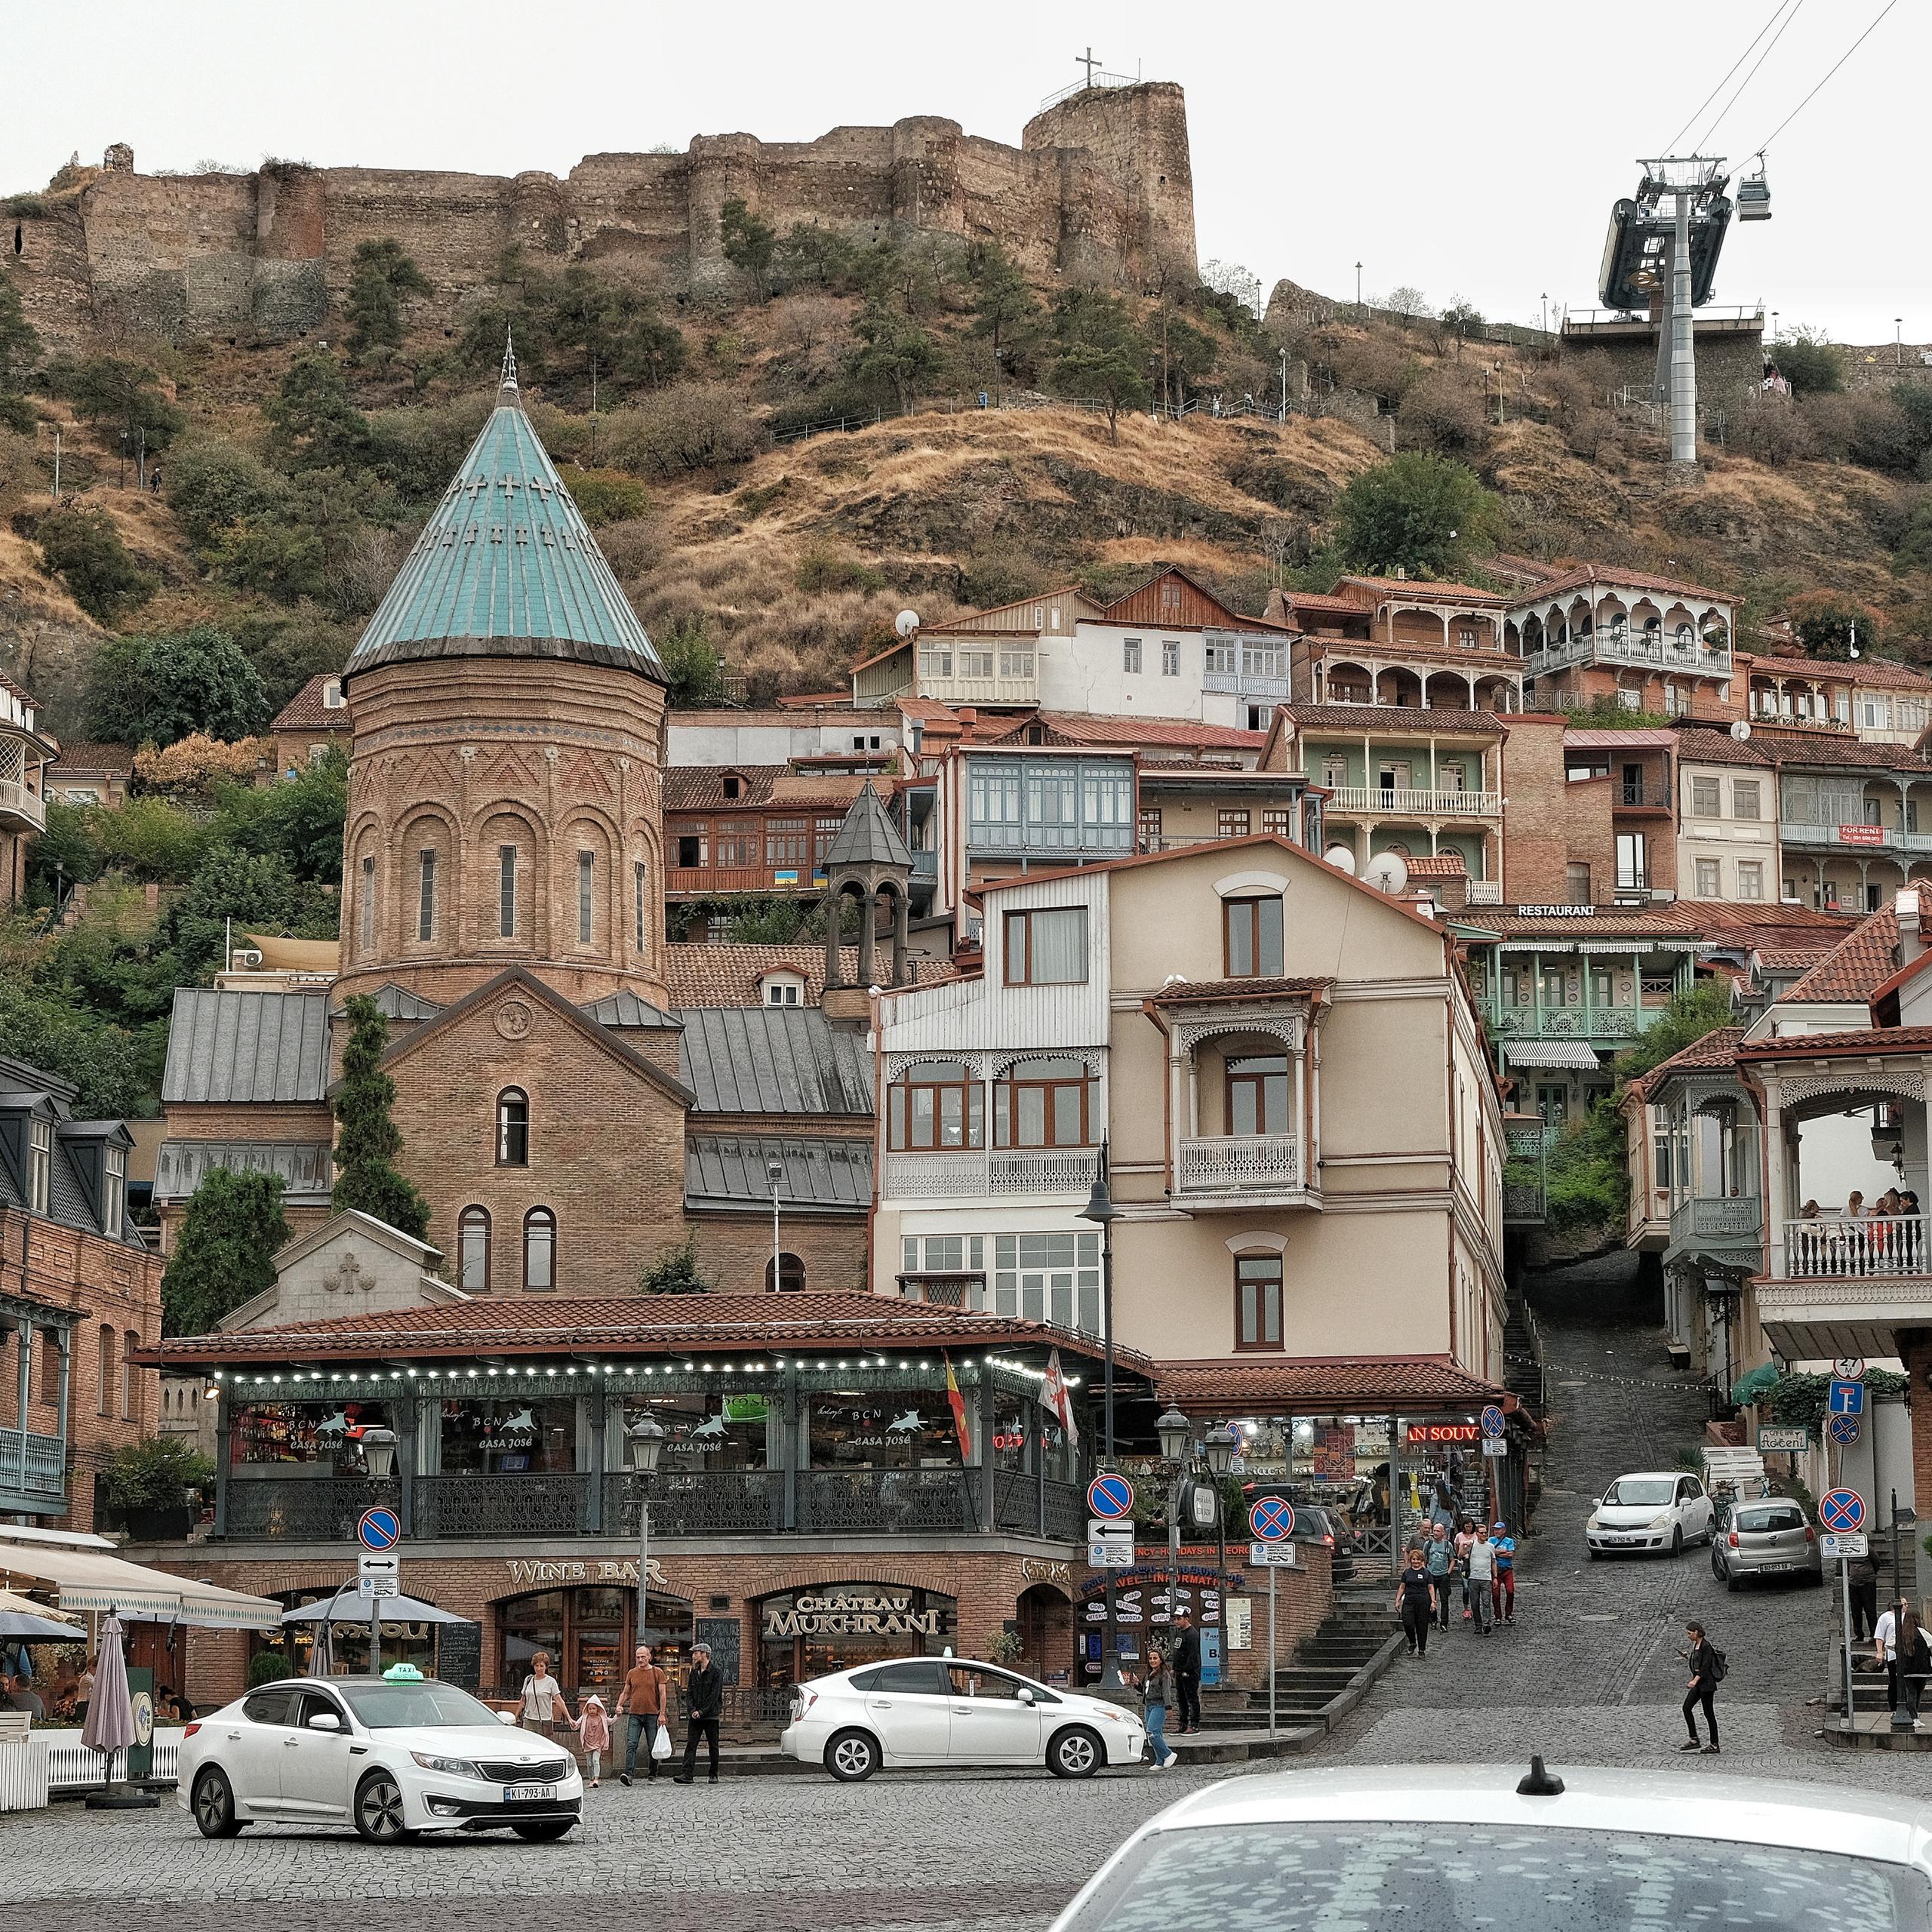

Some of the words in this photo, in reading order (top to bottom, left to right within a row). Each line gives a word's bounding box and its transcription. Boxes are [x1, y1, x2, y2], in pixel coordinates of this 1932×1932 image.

[1518, 906, 1596, 916] RESTAURANT
[290, 1441, 317, 1450] CASA
[319, 1438, 343, 1451] JOSÉ
[478, 1438, 506, 1449] CASA
[508, 1435, 533, 1449] JOSÉ
[854, 1435, 883, 1446] CASA
[885, 1433, 911, 1447] JOSÉ
[667, 1442, 694, 1452] CASA
[697, 1441, 721, 1453] JOSÉ
[1134, 1547, 1156, 1555] ENCY
[1160, 1546, 1203, 1555] HIDAYS
[1208, 1546, 1216, 1555] IN
[506, 1560, 586, 1584] WINE
[597, 1559, 668, 1585] BAR
[1097, 1575, 1140, 1593] TAVEL
[1153, 1573, 1235, 1588] INFRMATIN
[796, 1592, 909, 1613] CHÂTEAU
[764, 1609, 939, 1636] MUKHRANI
[698, 1623, 709, 1636] IF
[511, 1787, 551, 1800] KI-793-AA
